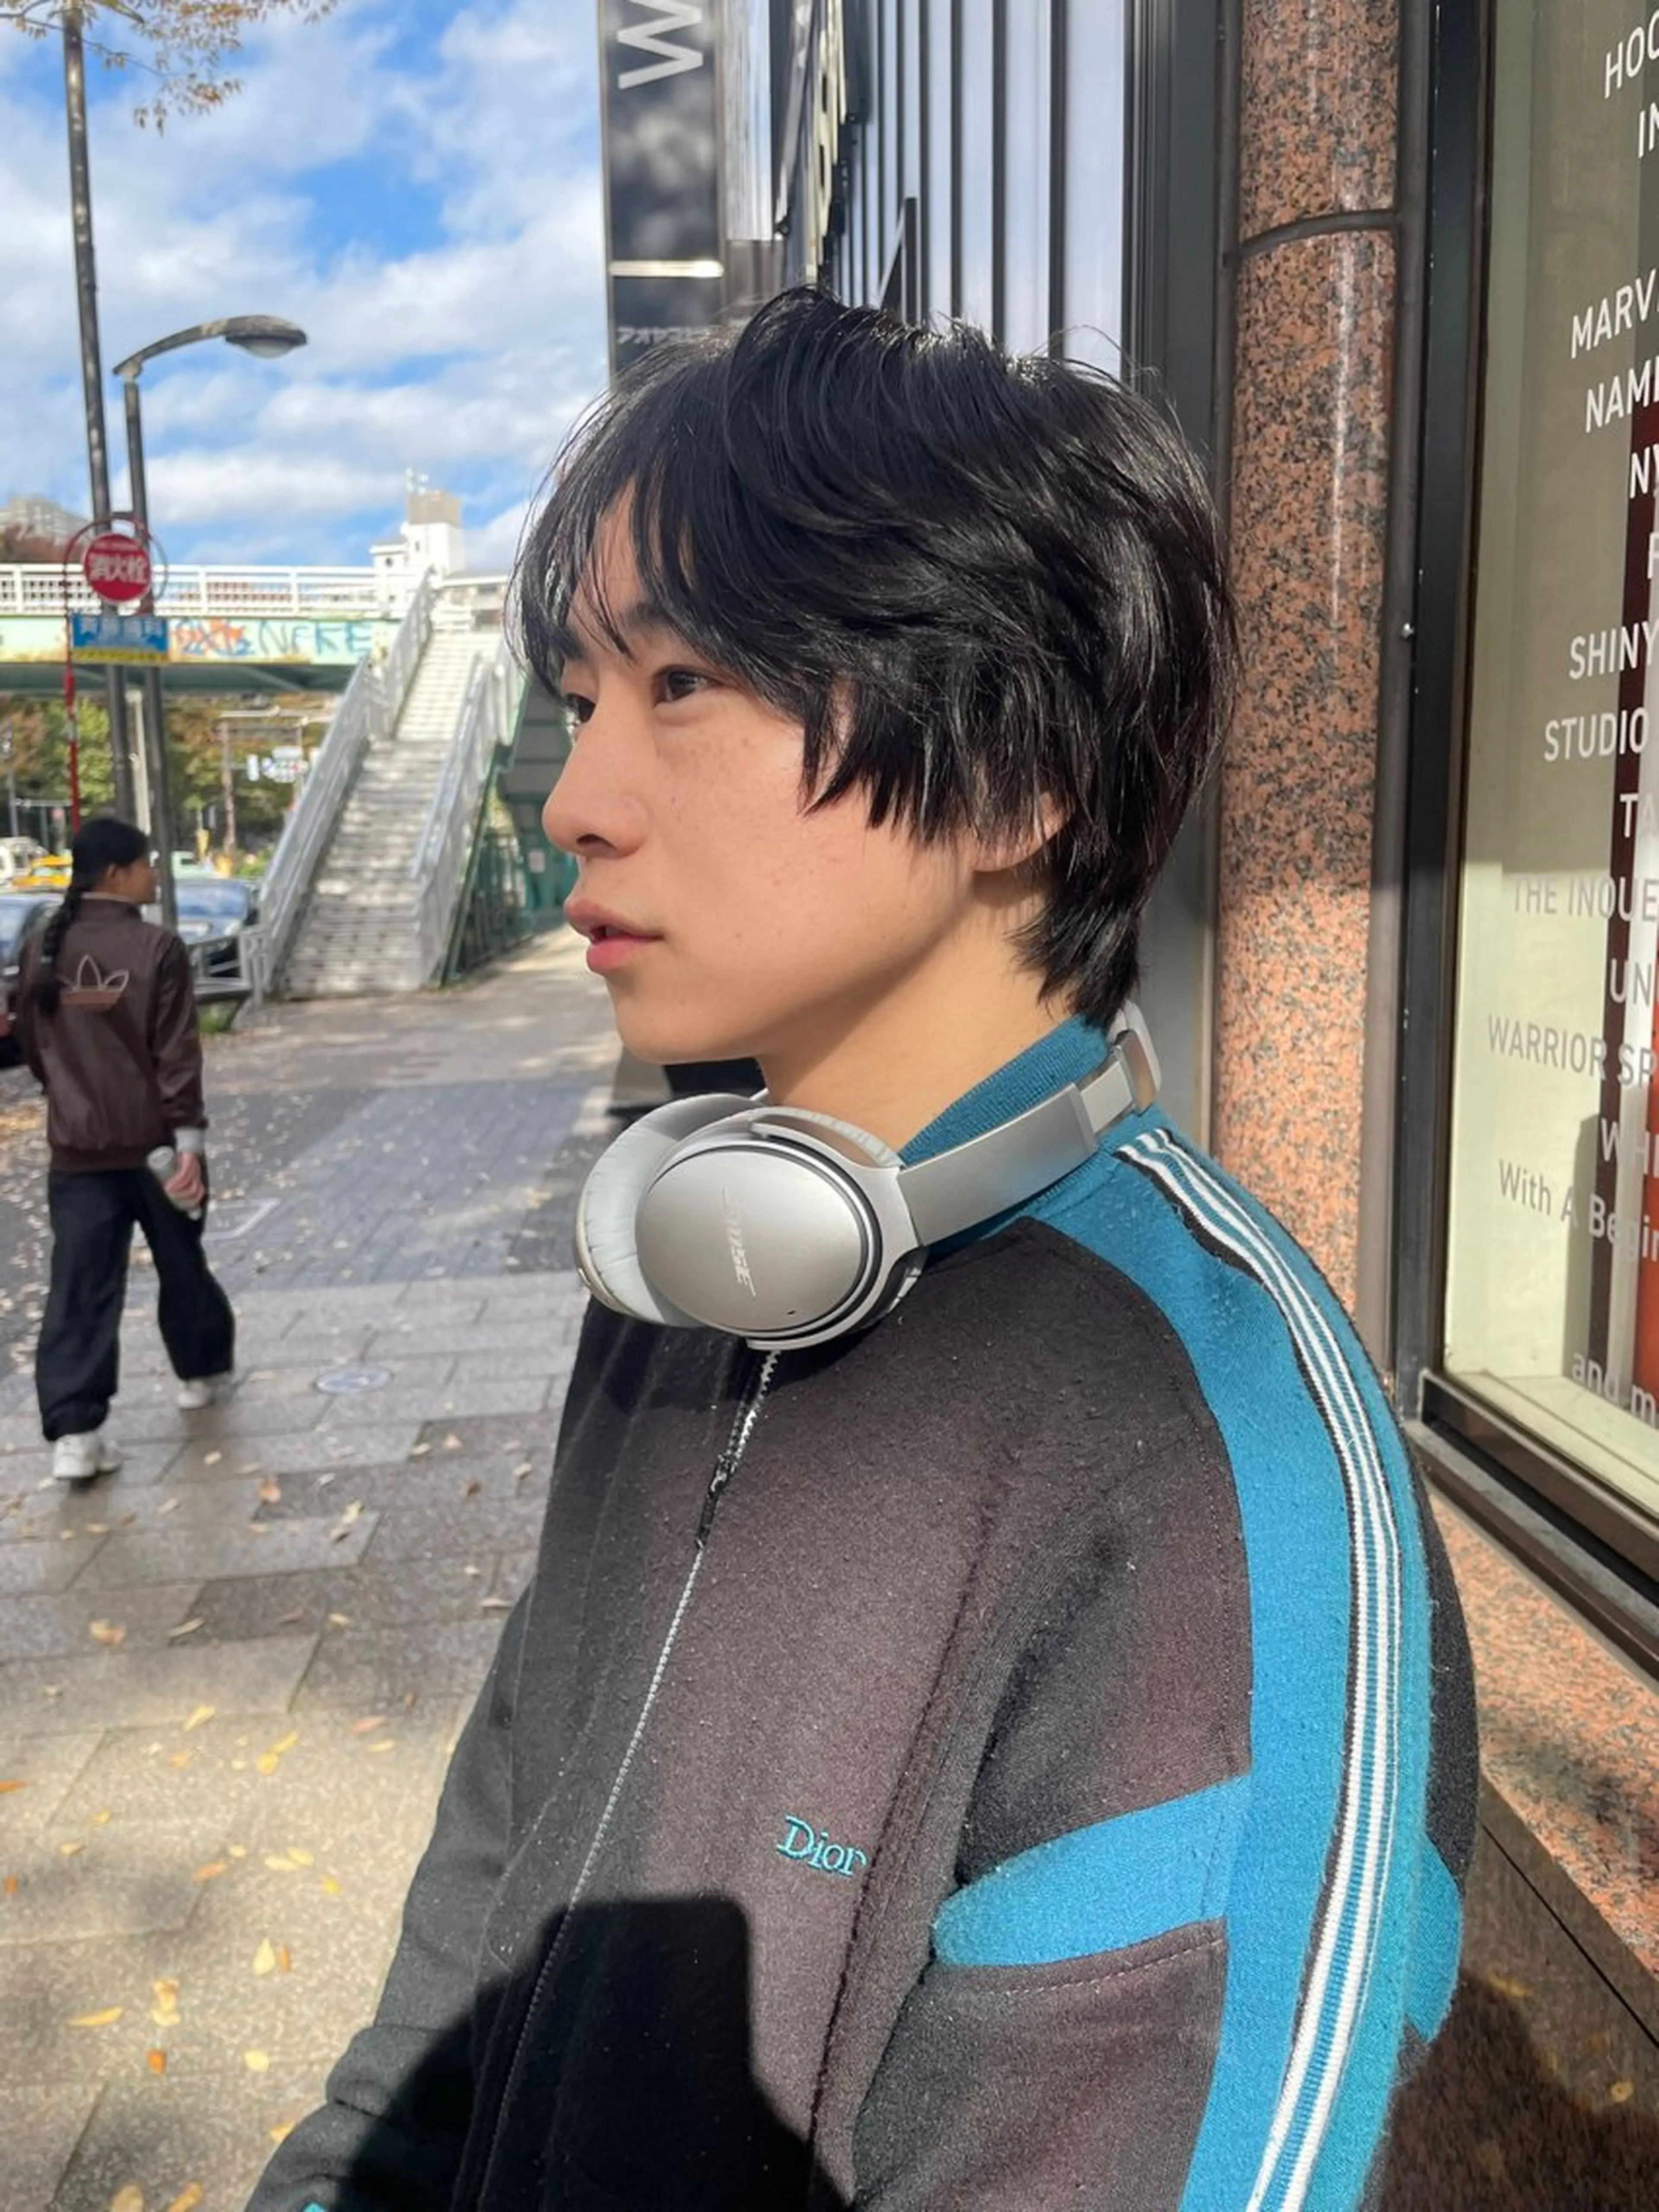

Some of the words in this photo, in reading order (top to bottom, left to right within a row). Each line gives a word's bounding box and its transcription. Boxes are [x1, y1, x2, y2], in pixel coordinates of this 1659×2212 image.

[1571, 268, 1659, 359] MARV
[87, 553, 149, 583] 消火栓
[1544, 707, 1649, 762] STUDIO
[1513, 876, 1557, 915] THE
[1569, 876, 1659, 922] INOUE
[1487, 1012, 1607, 1080] WARRIOR
[1499, 1158, 1551, 1216] With
[1560, 1185, 1579, 1229] A
[776, 1815, 867, 1877] Dior
